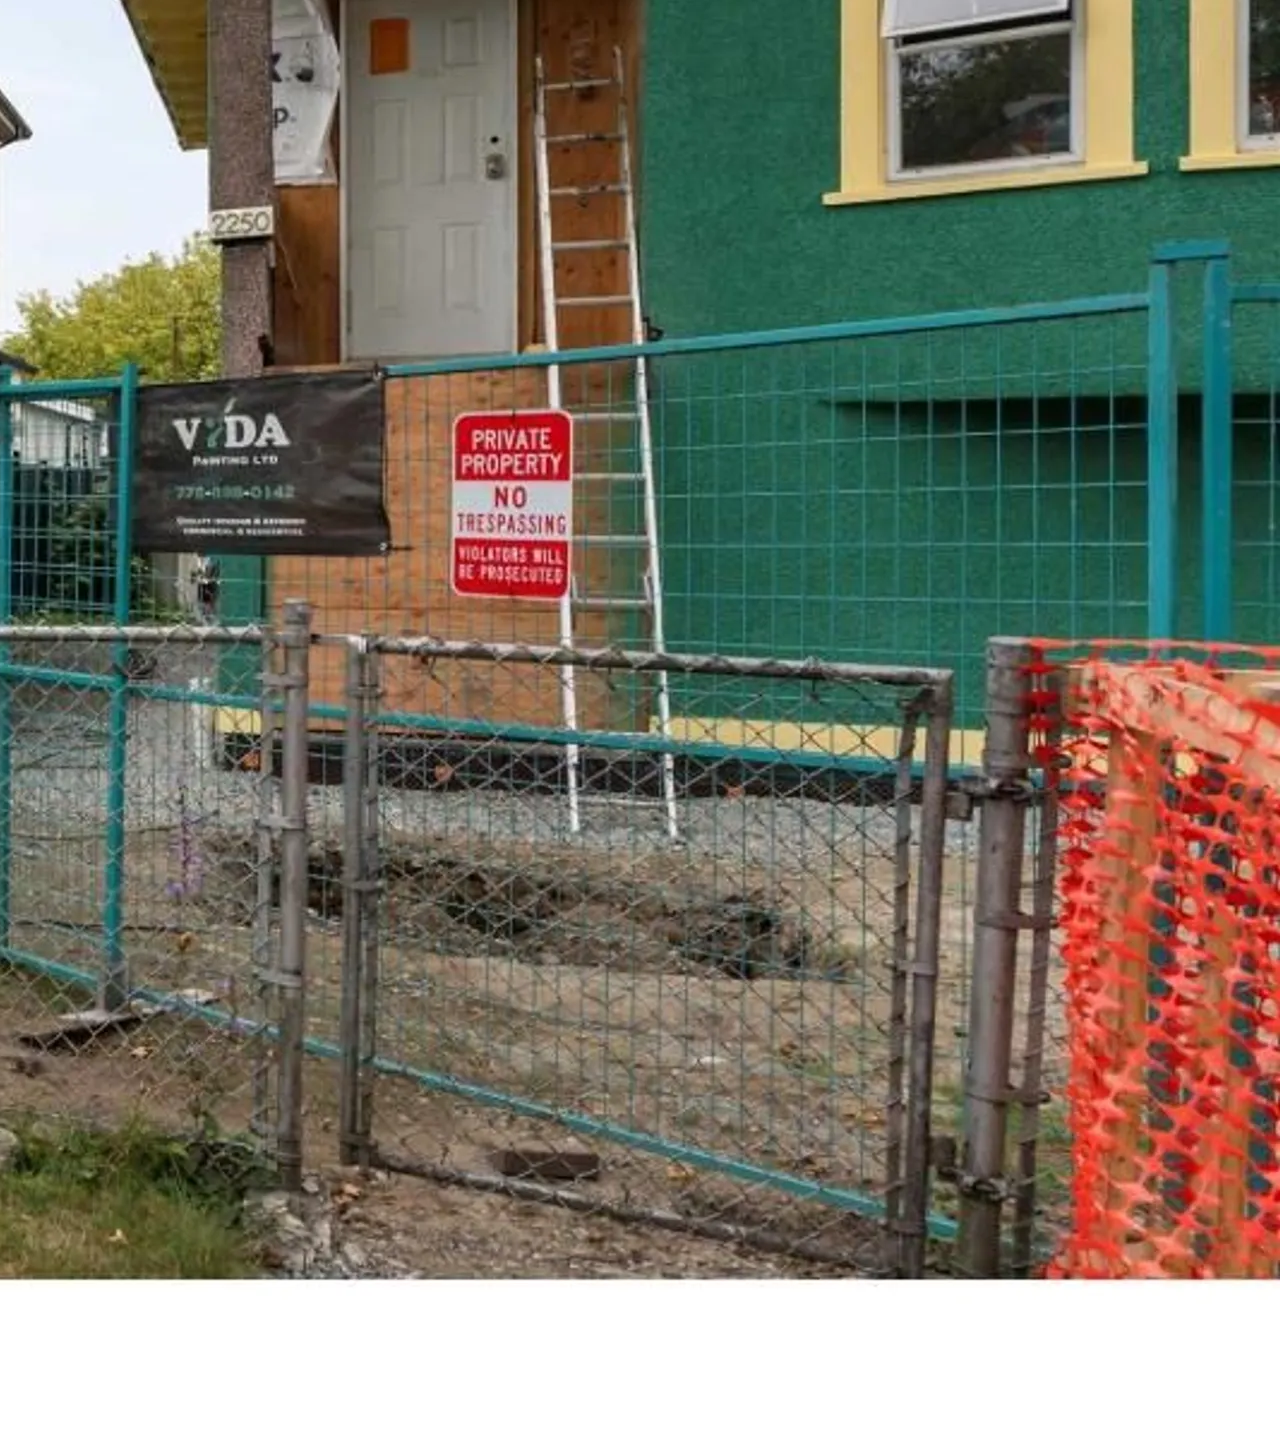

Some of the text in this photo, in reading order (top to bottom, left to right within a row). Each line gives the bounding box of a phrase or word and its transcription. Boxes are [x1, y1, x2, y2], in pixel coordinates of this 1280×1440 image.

[211, 211, 271, 235] 2250
[470, 427, 553, 451] PRIVATE
[460, 453, 563, 477] PROPERTY
[493, 485, 528, 509] NO
[456, 512, 567, 535] TRESPASSING
[458, 545, 565, 566] VIOLATORS WILL
[458, 563, 565, 585] BE PROSECUTED
